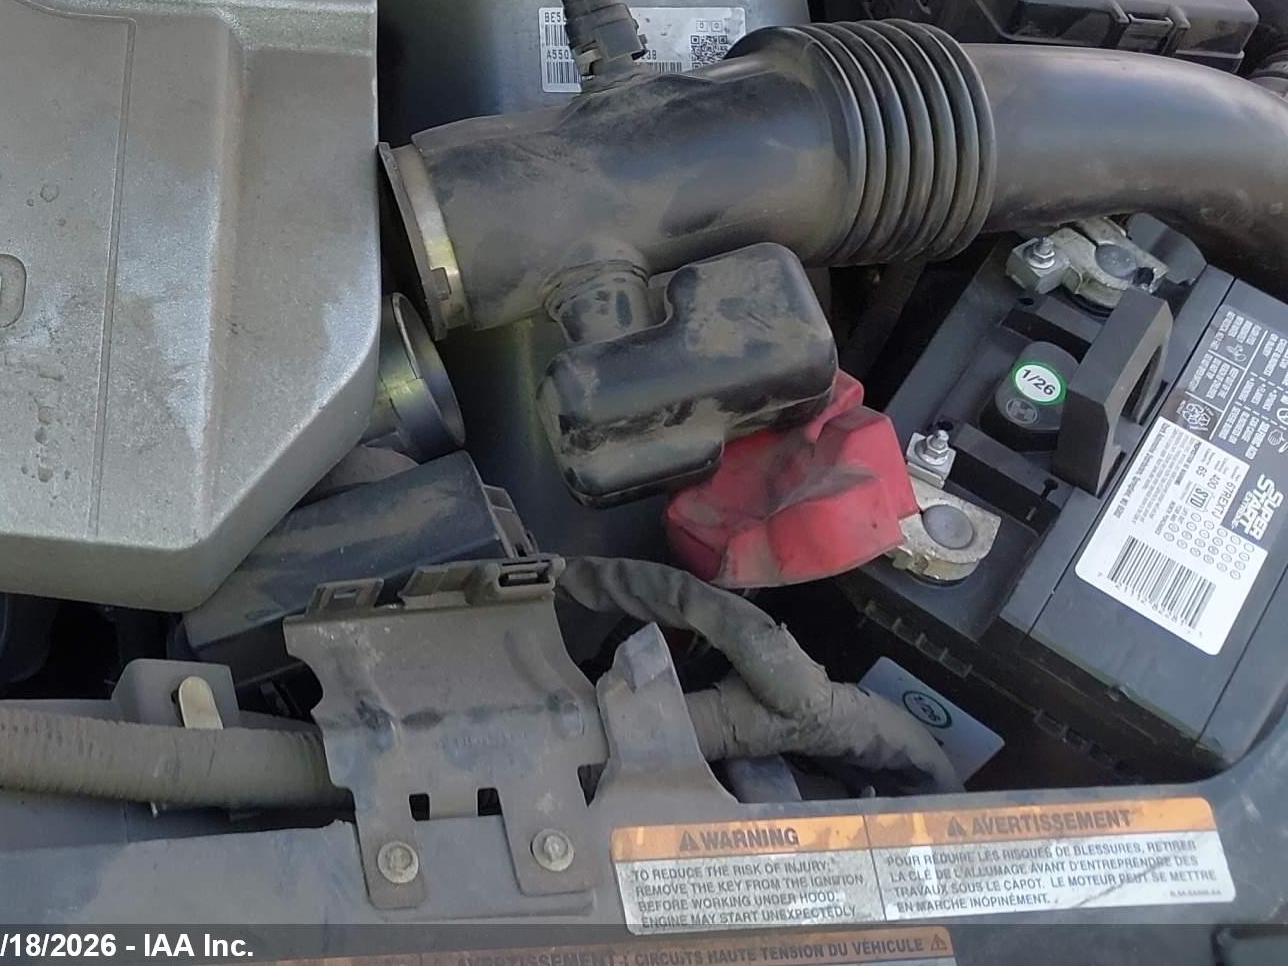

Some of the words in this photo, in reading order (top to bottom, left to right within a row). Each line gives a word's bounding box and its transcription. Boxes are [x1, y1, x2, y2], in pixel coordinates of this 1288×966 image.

[1022, 369, 1056, 395] 1/26
[1195, 465, 1207, 477] 65
[1206, 473, 1220, 489] 400
[1189, 487, 1208, 508] STD
[1211, 481, 1236, 519] 67REXTJ
[1232, 473, 1274, 534] START
[1249, 487, 1283, 540] SUPER
[971, 809, 1132, 835] AVERTISSEMENT
[700, 827, 800, 851] WARNING
[887, 855, 920, 867] POUR
[977, 849, 1000, 861] LES
[1002, 846, 1052, 860] RISQUES
[1055, 846, 1071, 856] DE
[1074, 842, 1145, 856] BLESSURES,
[1146, 840, 1197, 852] RETIRER
[633, 870, 649, 882] TO
[652, 867, 703, 880] REDUCE
[707, 865, 729, 877] THE
[733, 863, 761, 876] RISK
[764, 862, 781, 873] OF
[890, 872, 906, 883] LA
[936, 869, 951, 880] DE
[1031, 860, 1066, 873] AVANT
[1069, 855, 1172, 872] D'ENTREPRENDRE
[1175, 855, 1199, 866] DES
[635, 885, 688, 897] REMOVE
[691, 882, 714, 894] THE
[718, 881, 742, 893] KEY
[745, 878, 780, 890] FROM
[783, 876, 807, 889] THE
[811, 872, 864, 887] IGNITION
[894, 883, 949, 897] TRAVAUX
[951, 881, 984, 894] SOUS
[986, 880, 1000, 891] LE
[1002, 878, 1045, 891] CAPOT.
[1050, 876, 1065, 888] LE
[1067, 873, 1117, 887] MOTEUR
[1119, 872, 1149, 884] PEUT
[1152, 871, 1167, 882] SE
[1169, 869, 1217, 882] METTRE
[638, 899, 688, 912] BEFORE
[691, 896, 751, 909] WORKING
[754, 893, 796, 906] UNDER
[801, 890, 840, 902] HOOD.
[896, 901, 914, 913] EN
[917, 897, 967, 912] MARCHE
[640, 914, 689, 928] ENGINE
[691, 912, 716, 926] MAY
[719, 909, 758, 924] START
[761, 905, 857, 922] UNEXPECTEDLY
[760, 943, 825, 961] TENSION
[828, 941, 849, 957] DU
